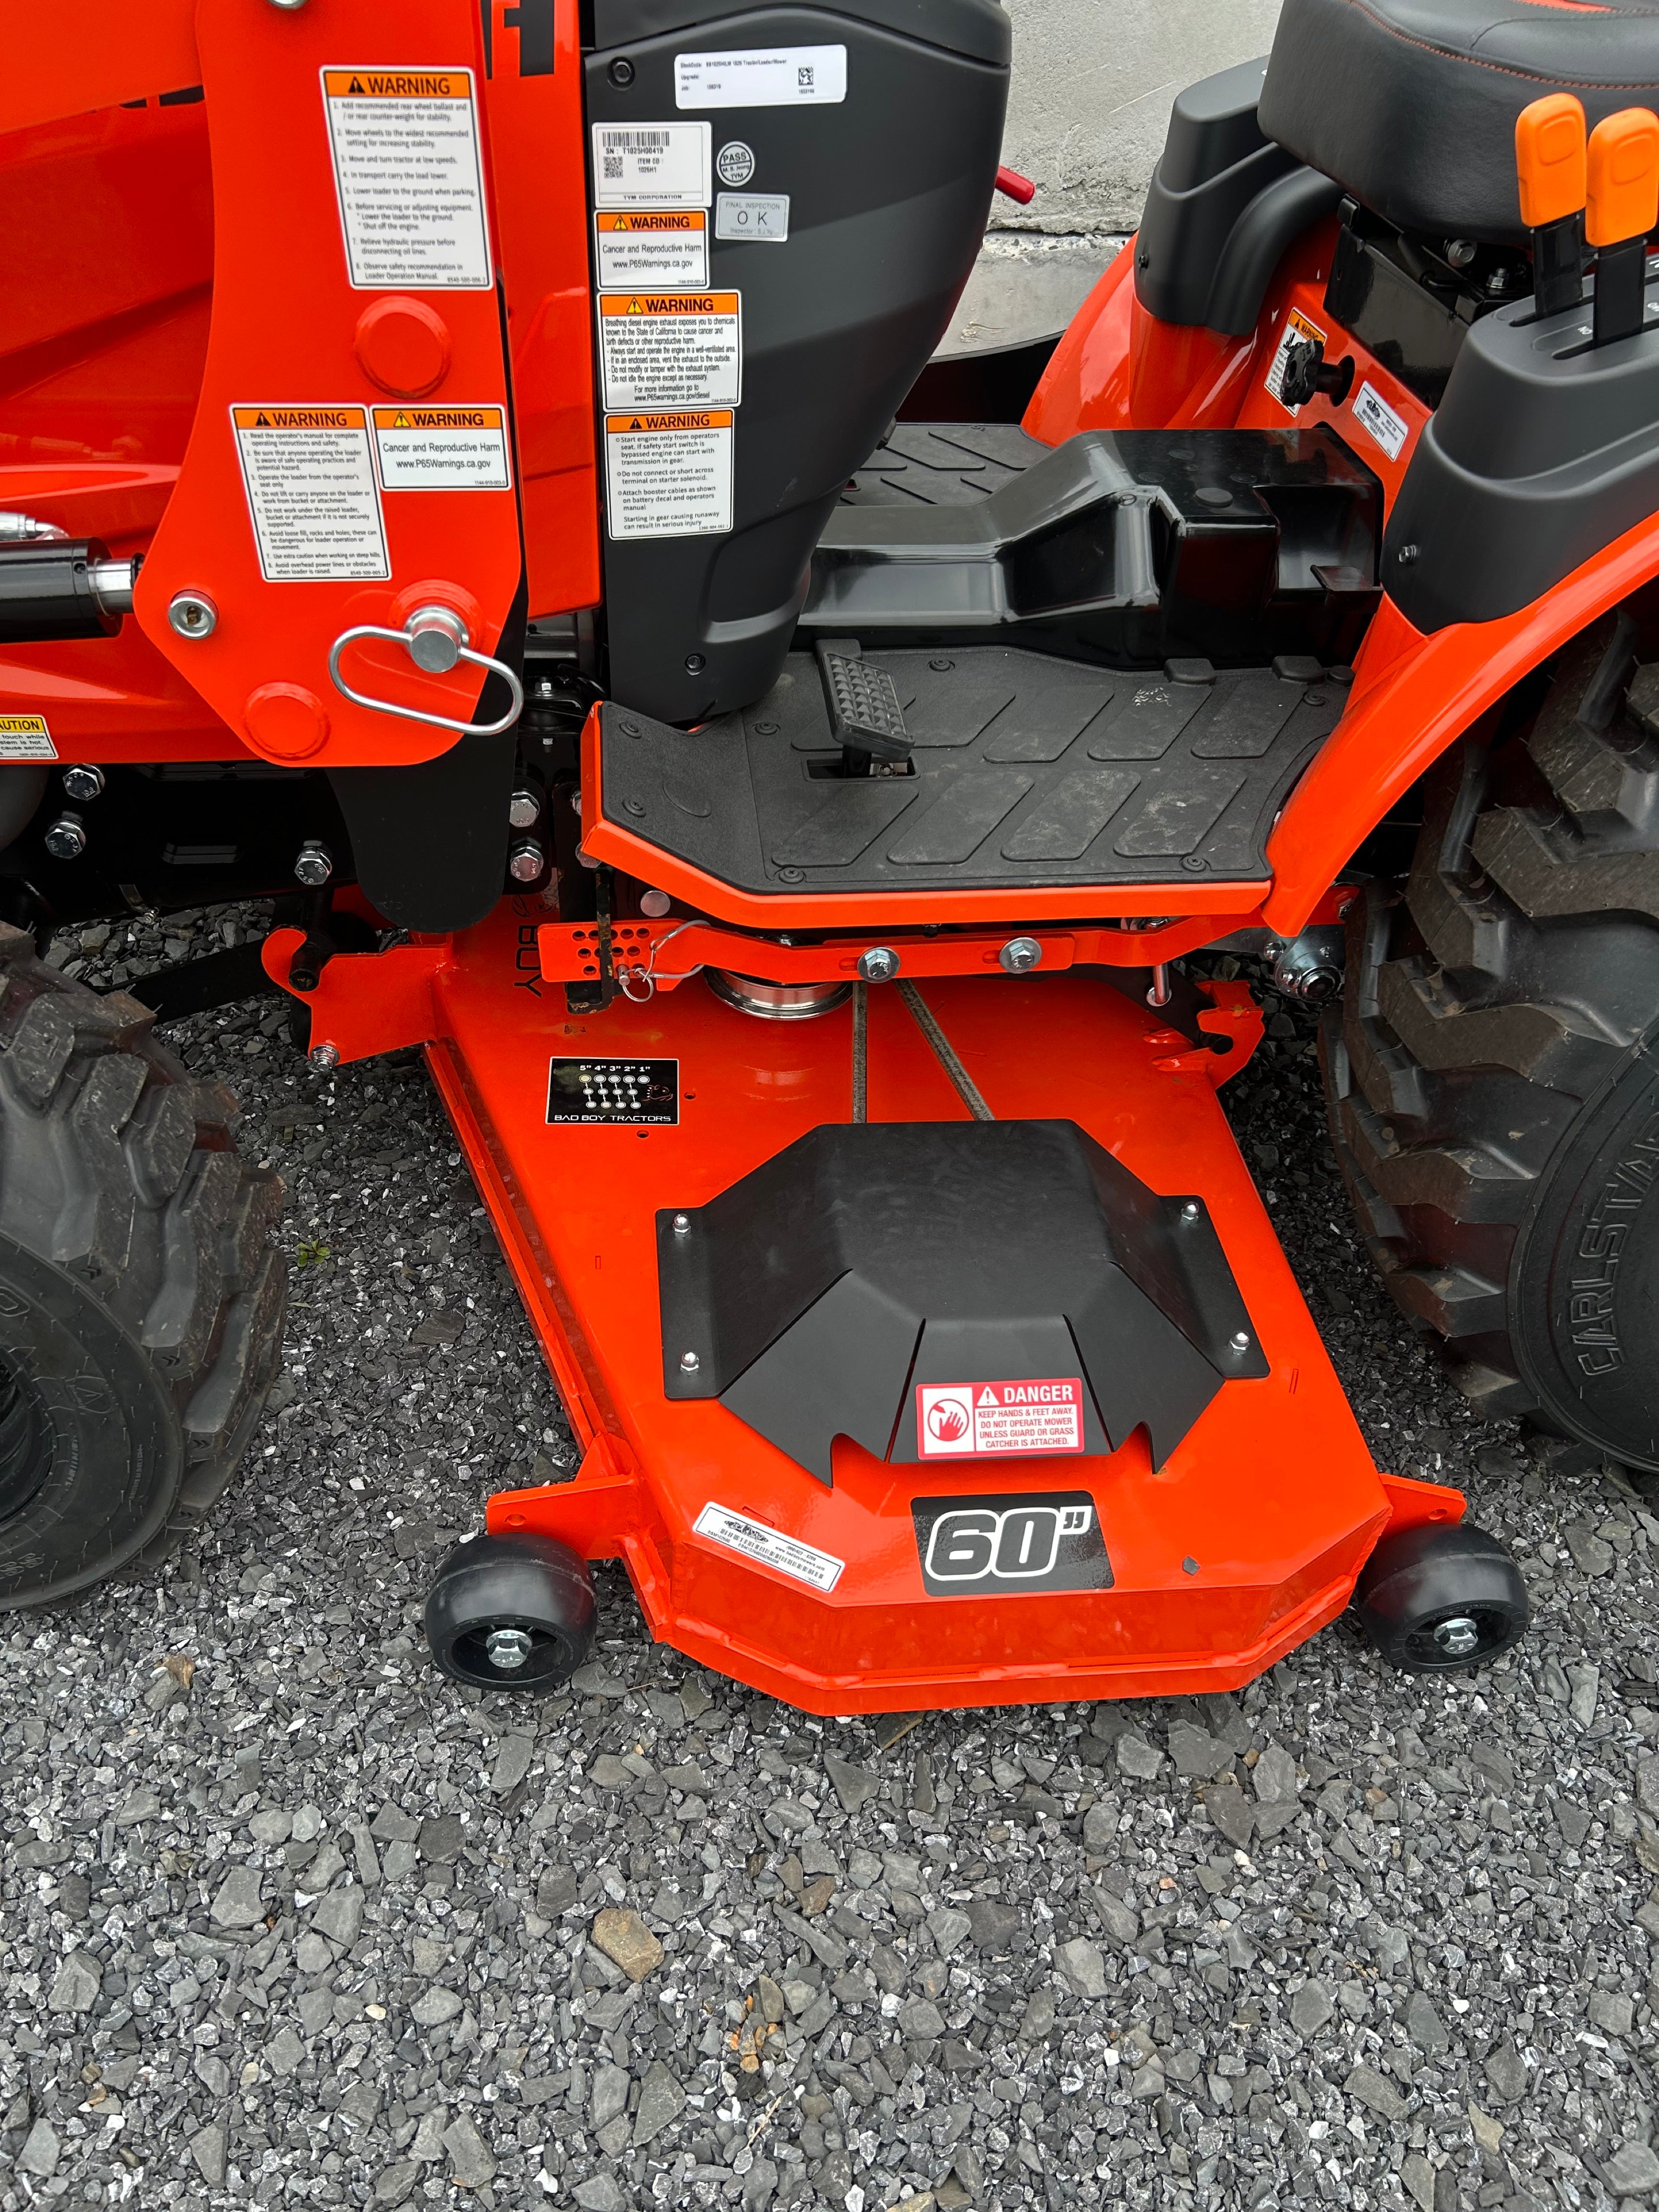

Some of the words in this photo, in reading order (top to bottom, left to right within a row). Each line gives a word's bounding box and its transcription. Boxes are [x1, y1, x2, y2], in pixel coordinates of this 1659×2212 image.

[368, 77, 450, 94] WARNING
[723, 151, 746, 163] PASS
[630, 216, 690, 228] WARNING
[602, 245, 625, 253] Cancer
[627, 245, 639, 253] and
[642, 244, 682, 254] Reproductive
[685, 244, 702, 252] Harm
[613, 259, 693, 269] www.P65Warnings.ca.gov
[386, 272, 415, 280] Operation
[645, 298, 714, 312] WARNING
[605, 319, 627, 328] Breathing
[643, 319, 658, 327] engine
[698, 319, 707, 327] you
[273, 413, 348, 426] WARNING
[412, 413, 484, 426] WARNING
[646, 414, 710, 429] WARNING
[383, 443, 409, 452] Cancer
[412, 443, 426, 452] and
[429, 443, 477, 454] Reproductive
[480, 443, 500, 452] Harm
[396, 459, 491, 470] www.P65Warnings.ca.gov
[1004, 1385, 1073, 1404] DANGER
[1010, 1419, 1042, 1427] OPERATE
[986, 1440, 1019, 1448] CATCHER
